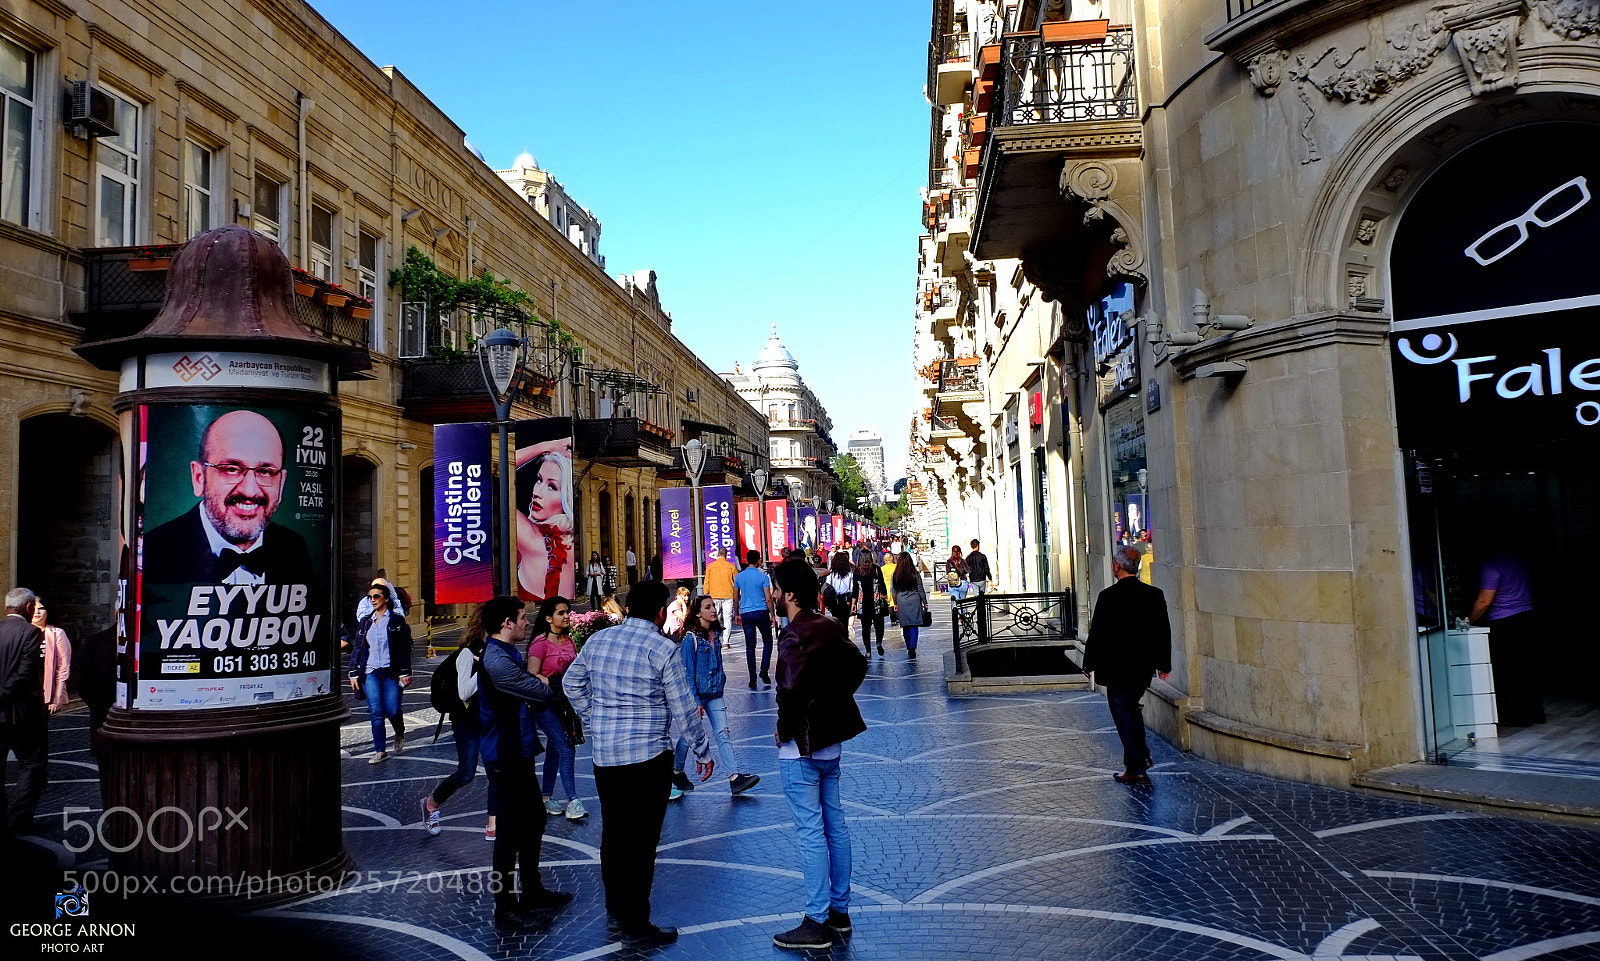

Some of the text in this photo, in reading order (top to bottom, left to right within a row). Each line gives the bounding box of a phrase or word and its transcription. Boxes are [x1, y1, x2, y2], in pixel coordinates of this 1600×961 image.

[302, 425, 324, 448] 22
[296, 444, 327, 466] İYUN
[298, 495, 324, 508] TEATR
[300, 481, 323, 496] YAŞIL
[443, 461, 463, 565] Christina
[462, 464, 487, 562] Aguilera
[720, 501, 734, 559] grosso
[668, 509, 682, 555] 28 Aprel
[706, 516, 719, 560] Axwell
[187, 583, 308, 616] EYYUB
[156, 614, 321, 652] YAQUBOV
[213, 650, 316, 673] 051 303 35 40
